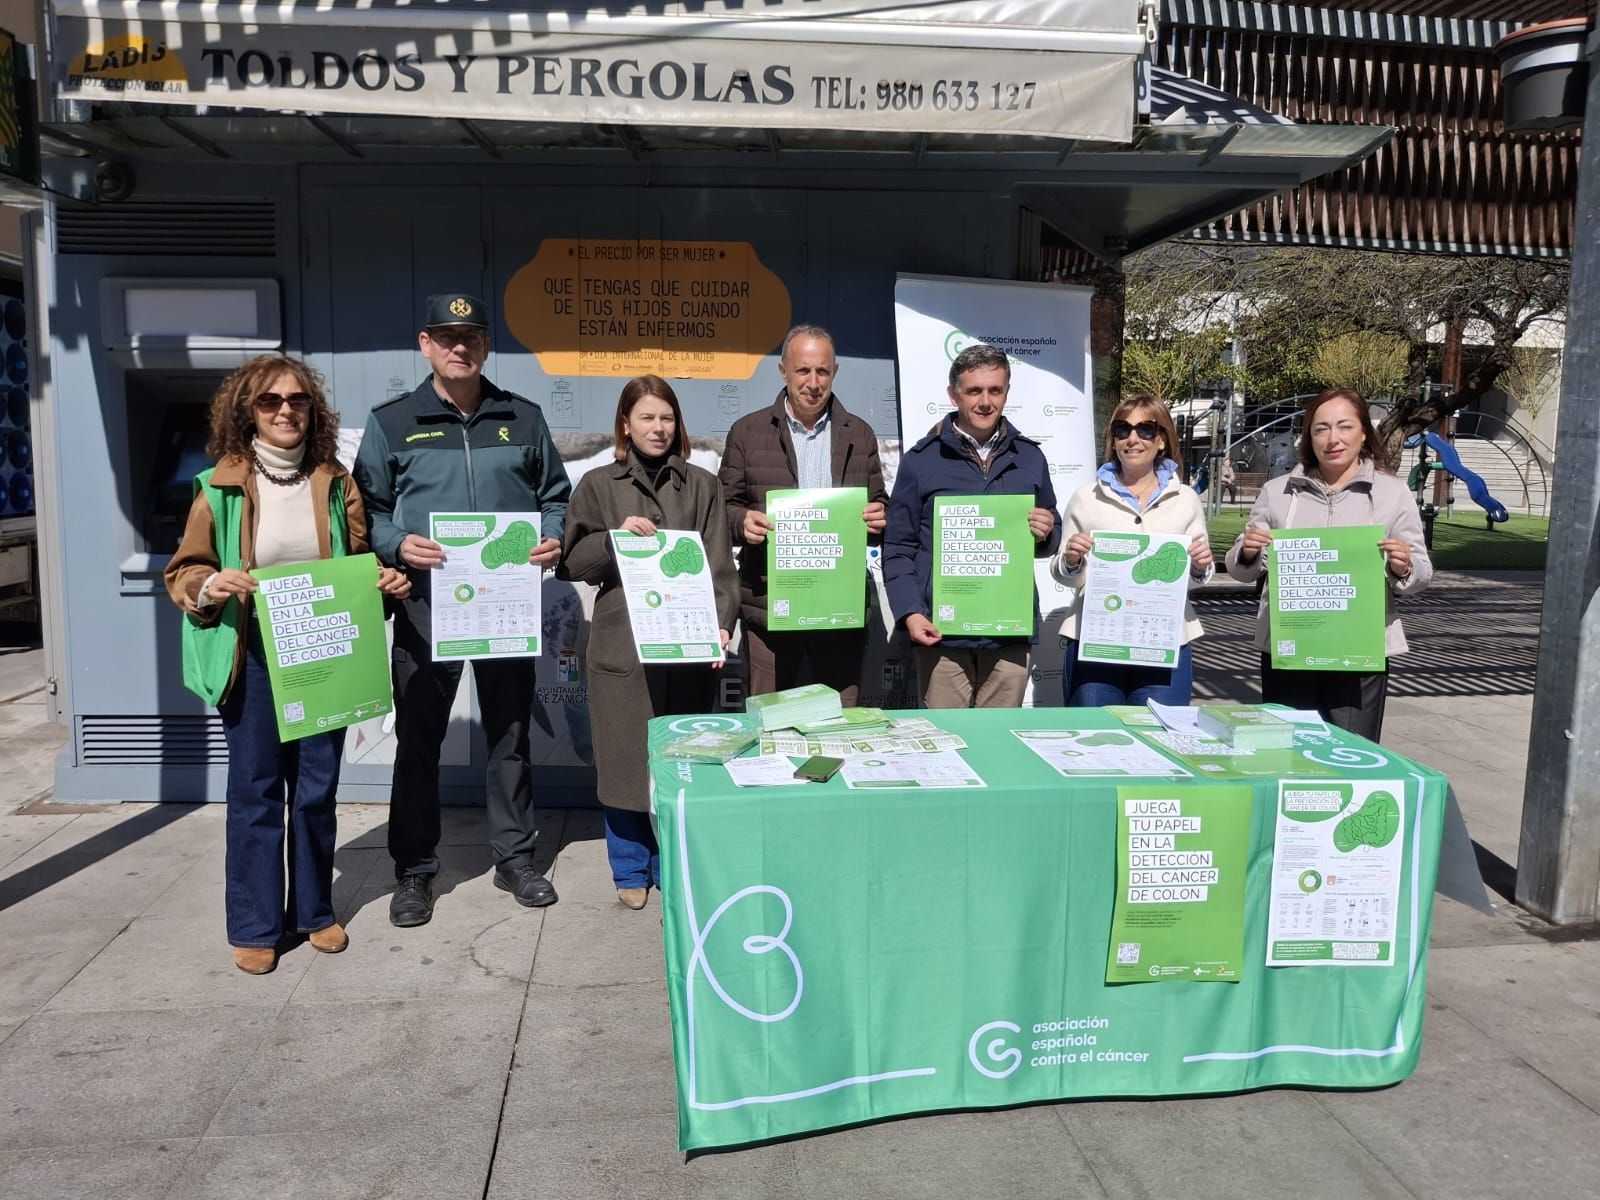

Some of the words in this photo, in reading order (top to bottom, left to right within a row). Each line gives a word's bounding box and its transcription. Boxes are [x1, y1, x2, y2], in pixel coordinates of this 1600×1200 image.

[84, 41, 167, 73] LADIS
[201, 48, 426, 92] TOLDOS
[444, 55, 479, 94] Y
[496, 55, 796, 105] PERGOLAS
[810, 75, 867, 110] TEL:
[876, 80, 925, 111] 980
[932, 80, 979, 112] 633
[990, 81, 1037, 112] 127
[145, 81, 183, 93] SOLAR
[578, 246, 590, 260] EL
[595, 246, 632, 260] PRECIO
[637, 247, 653, 260] POR
[660, 248, 679, 261] SER
[684, 248, 715, 262] MUJER
[544, 278, 573, 295] QUE
[584, 279, 641, 296] TENGAS
[651, 280, 680, 297] QUE
[691, 281, 749, 298] CUIDAR
[554, 299, 573, 315] DE
[584, 300, 612, 316] TUS
[623, 301, 671, 317] HIJOS
[681, 302, 740, 318] CUANDO
[579, 316, 627, 336] ESTÁN
[638, 321, 715, 338] ENFERMOS
[978, 335, 1020, 345] asociación
[1021, 337, 1057, 347] española
[1005, 346, 1013, 354] el
[612, 351, 665, 361] INTERNACIONAL
[668, 352, 678, 361] DE
[681, 352, 690, 361] LA
[693, 353, 716, 362] MUJER
[794, 510, 826, 519] PAPEL
[944, 506, 977, 515] JUEGA
[777, 522, 792, 531] EN
[794, 522, 807, 531] LA
[944, 519, 957, 527] TU
[960, 518, 992, 527] PAPEL
[943, 530, 957, 538] EN
[960, 530, 973, 538] LA
[1280, 539, 1318, 549] JUEGA
[778, 547, 798, 556] DEL
[1280, 552, 1295, 561] TU
[1299, 551, 1336, 560] PAPEL
[778, 560, 793, 568] DE
[943, 554, 963, 562] DEL
[943, 566, 958, 574] DE
[1280, 565, 1296, 573] EN
[1299, 564, 1314, 573] LA
[267, 576, 310, 592] JUEGA
[269, 595, 287, 606] TU
[291, 588, 333, 604] PAPEL
[1280, 588, 1303, 598] DEL
[1281, 601, 1297, 610] DE
[272, 609, 290, 622] EN
[293, 605, 311, 618] LA
[278, 637, 304, 652] DEL
[281, 653, 298, 666] DE
[537, 686, 587, 694] AYUNTAMIEN
[536, 693, 550, 703] DE
[1132, 802, 1177, 814] JUEGA
[1132, 820, 1150, 831] TU
[1154, 819, 1198, 831] PAPEL
[1131, 837, 1150, 849] EN
[1154, 837, 1172, 848] LA
[1131, 872, 1160, 884] DEL
[1131, 890, 1151, 901] DE
[1032, 1016, 1108, 1033] asociación
[1031, 1033, 1097, 1051] española
[1030, 1052, 1077, 1067] contra
[1080, 1050, 1093, 1062] el
[1096, 1049, 1149, 1062] cáncer
